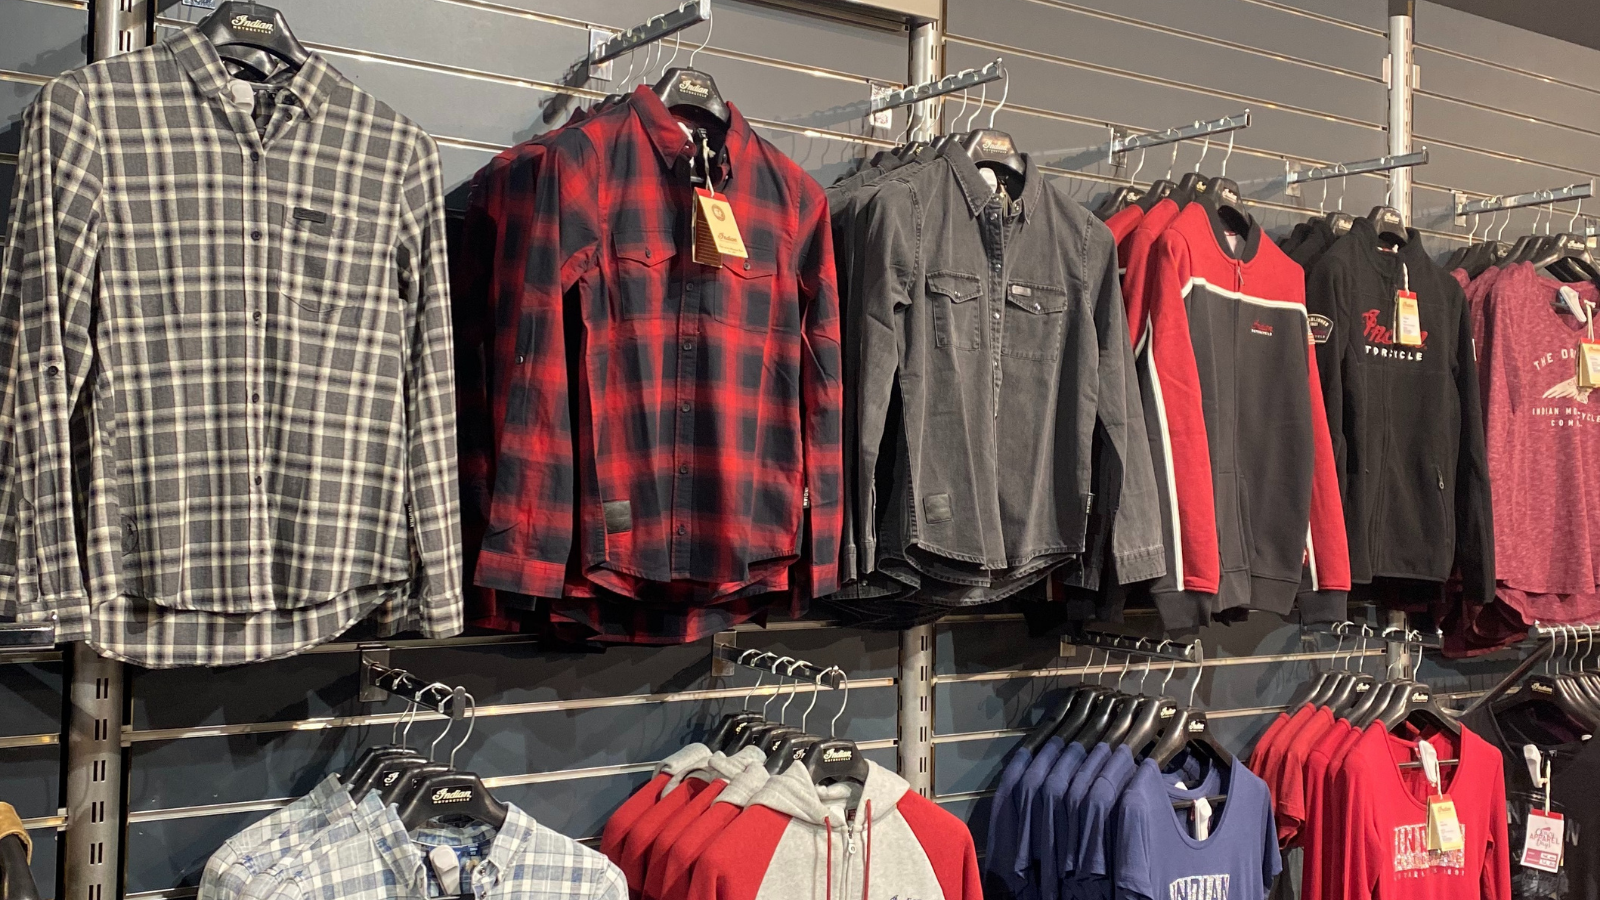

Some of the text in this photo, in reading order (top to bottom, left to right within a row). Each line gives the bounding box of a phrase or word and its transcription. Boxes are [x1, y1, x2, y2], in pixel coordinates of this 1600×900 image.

[231, 14, 274, 32] Indian
[679, 80, 709, 95] Indian
[1533, 352, 1554, 371] THE
[1532, 406, 1560, 416] INDIAN
[823, 748, 853, 760] Indian
[432, 788, 472, 801] Indian
[1529, 832, 1561, 846] APPAREL
